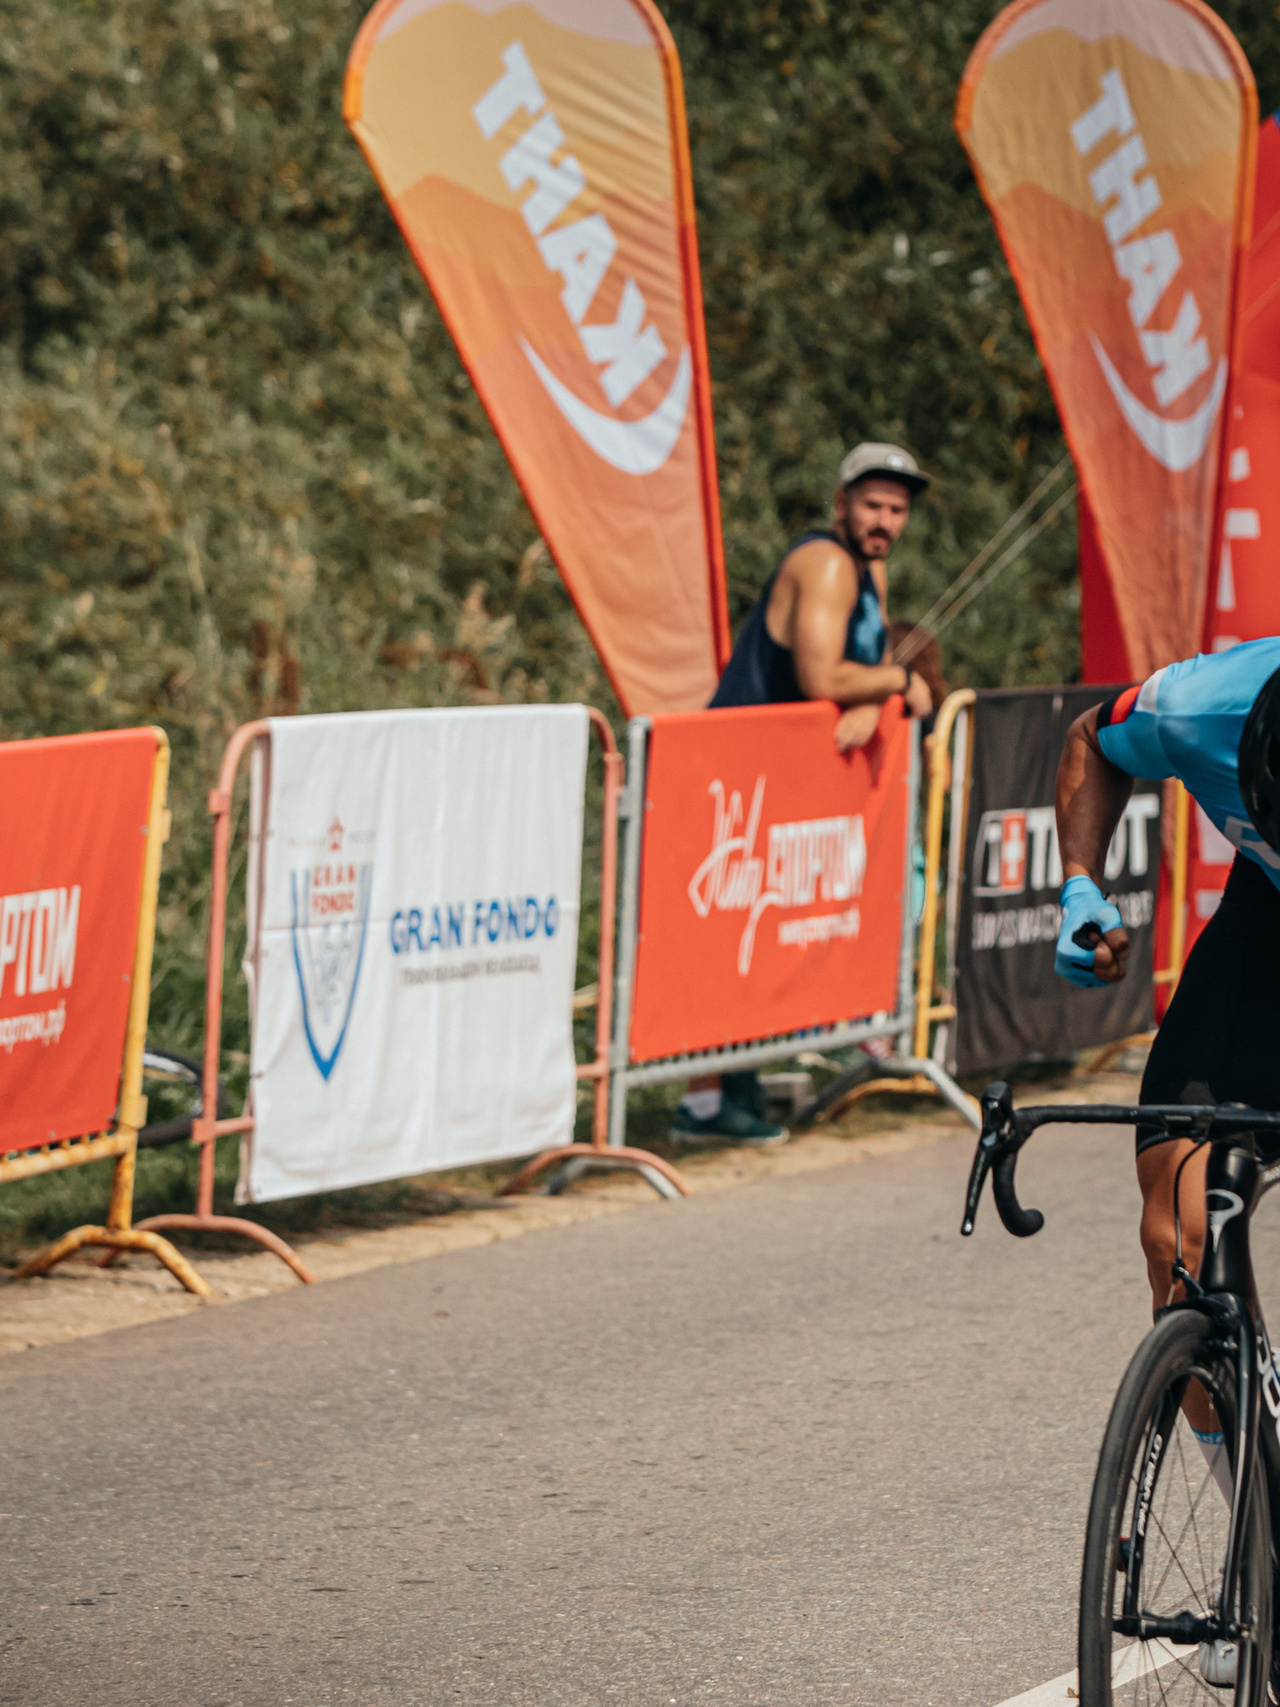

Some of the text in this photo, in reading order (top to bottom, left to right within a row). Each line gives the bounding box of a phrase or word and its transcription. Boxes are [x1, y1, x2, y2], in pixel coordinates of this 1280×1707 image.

[1025, 793, 1160, 891] TIOT
[390, 893, 560, 955] GRAN FONDO
